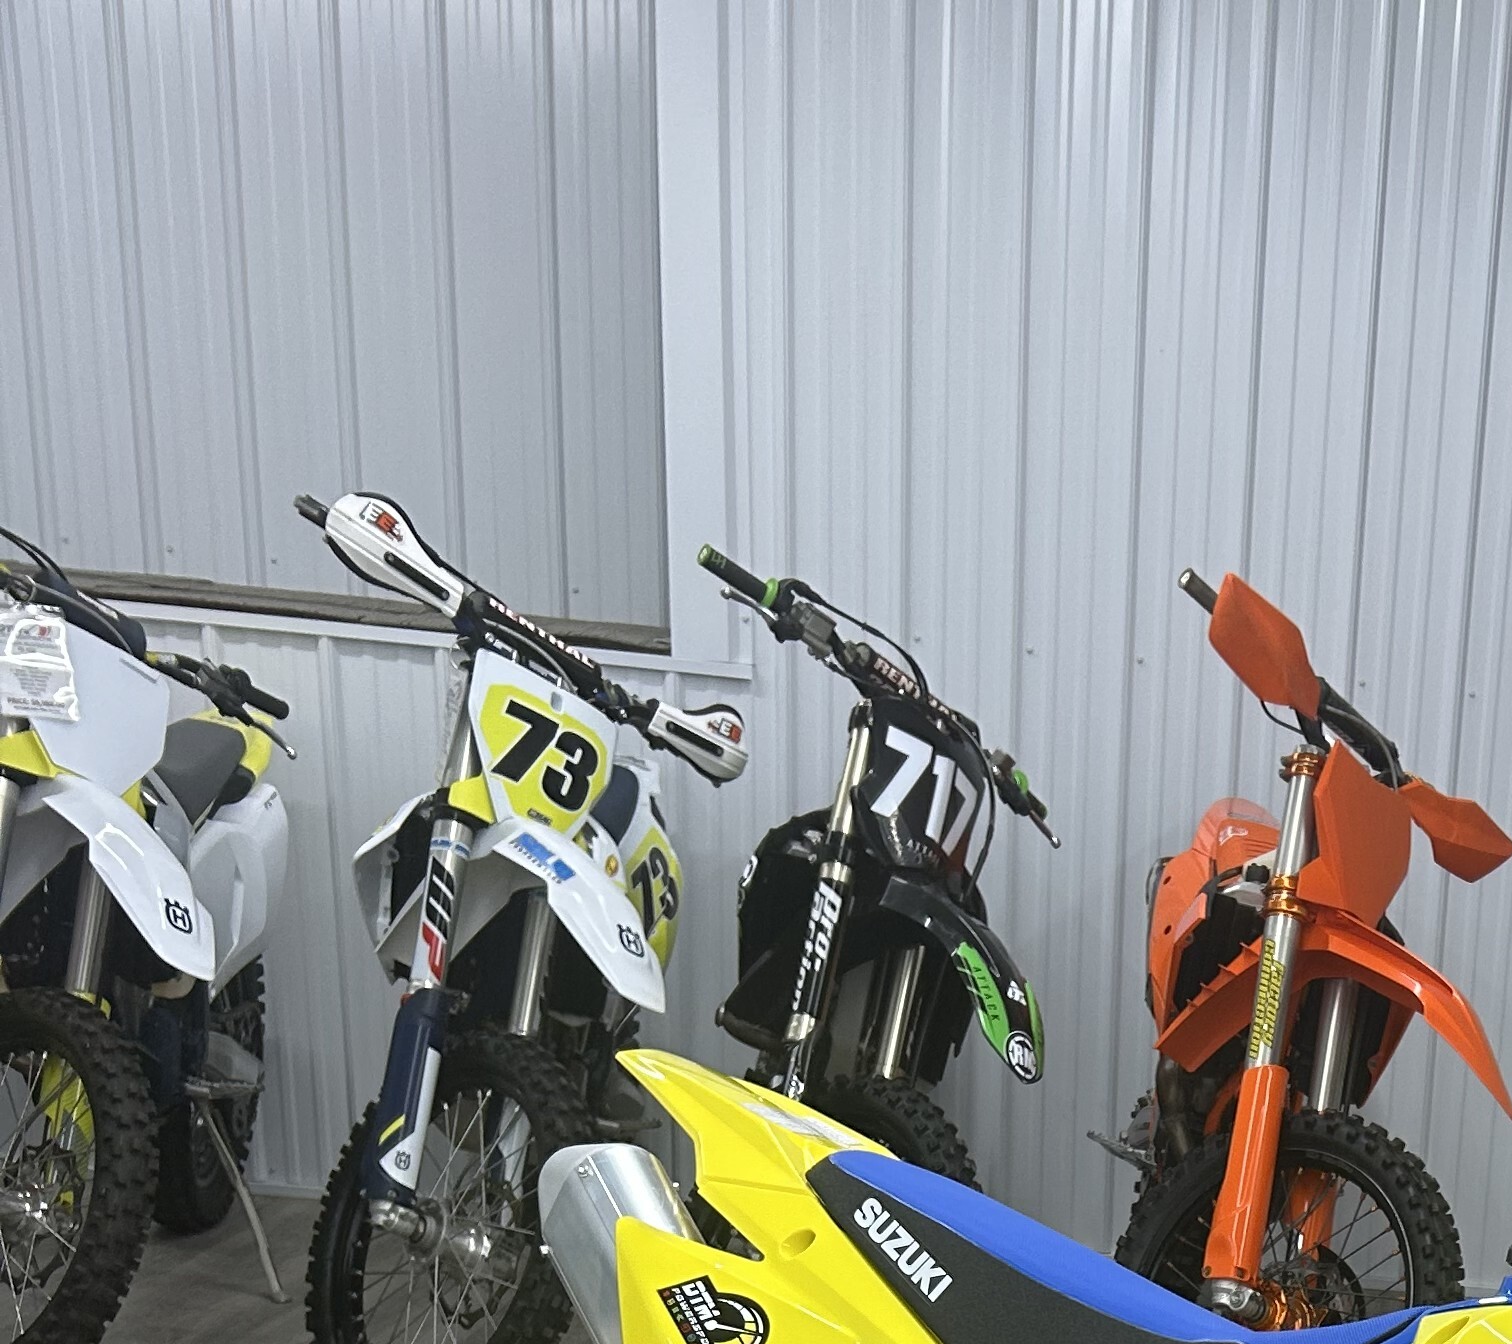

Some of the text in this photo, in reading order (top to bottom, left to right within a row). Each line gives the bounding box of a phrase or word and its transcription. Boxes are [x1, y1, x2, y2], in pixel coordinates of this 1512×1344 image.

[490, 699, 599, 812] 73
[630, 846, 679, 941] 73
[972, 966, 999, 1021] ATTACK
[853, 1197, 954, 1303] SUZUKI
